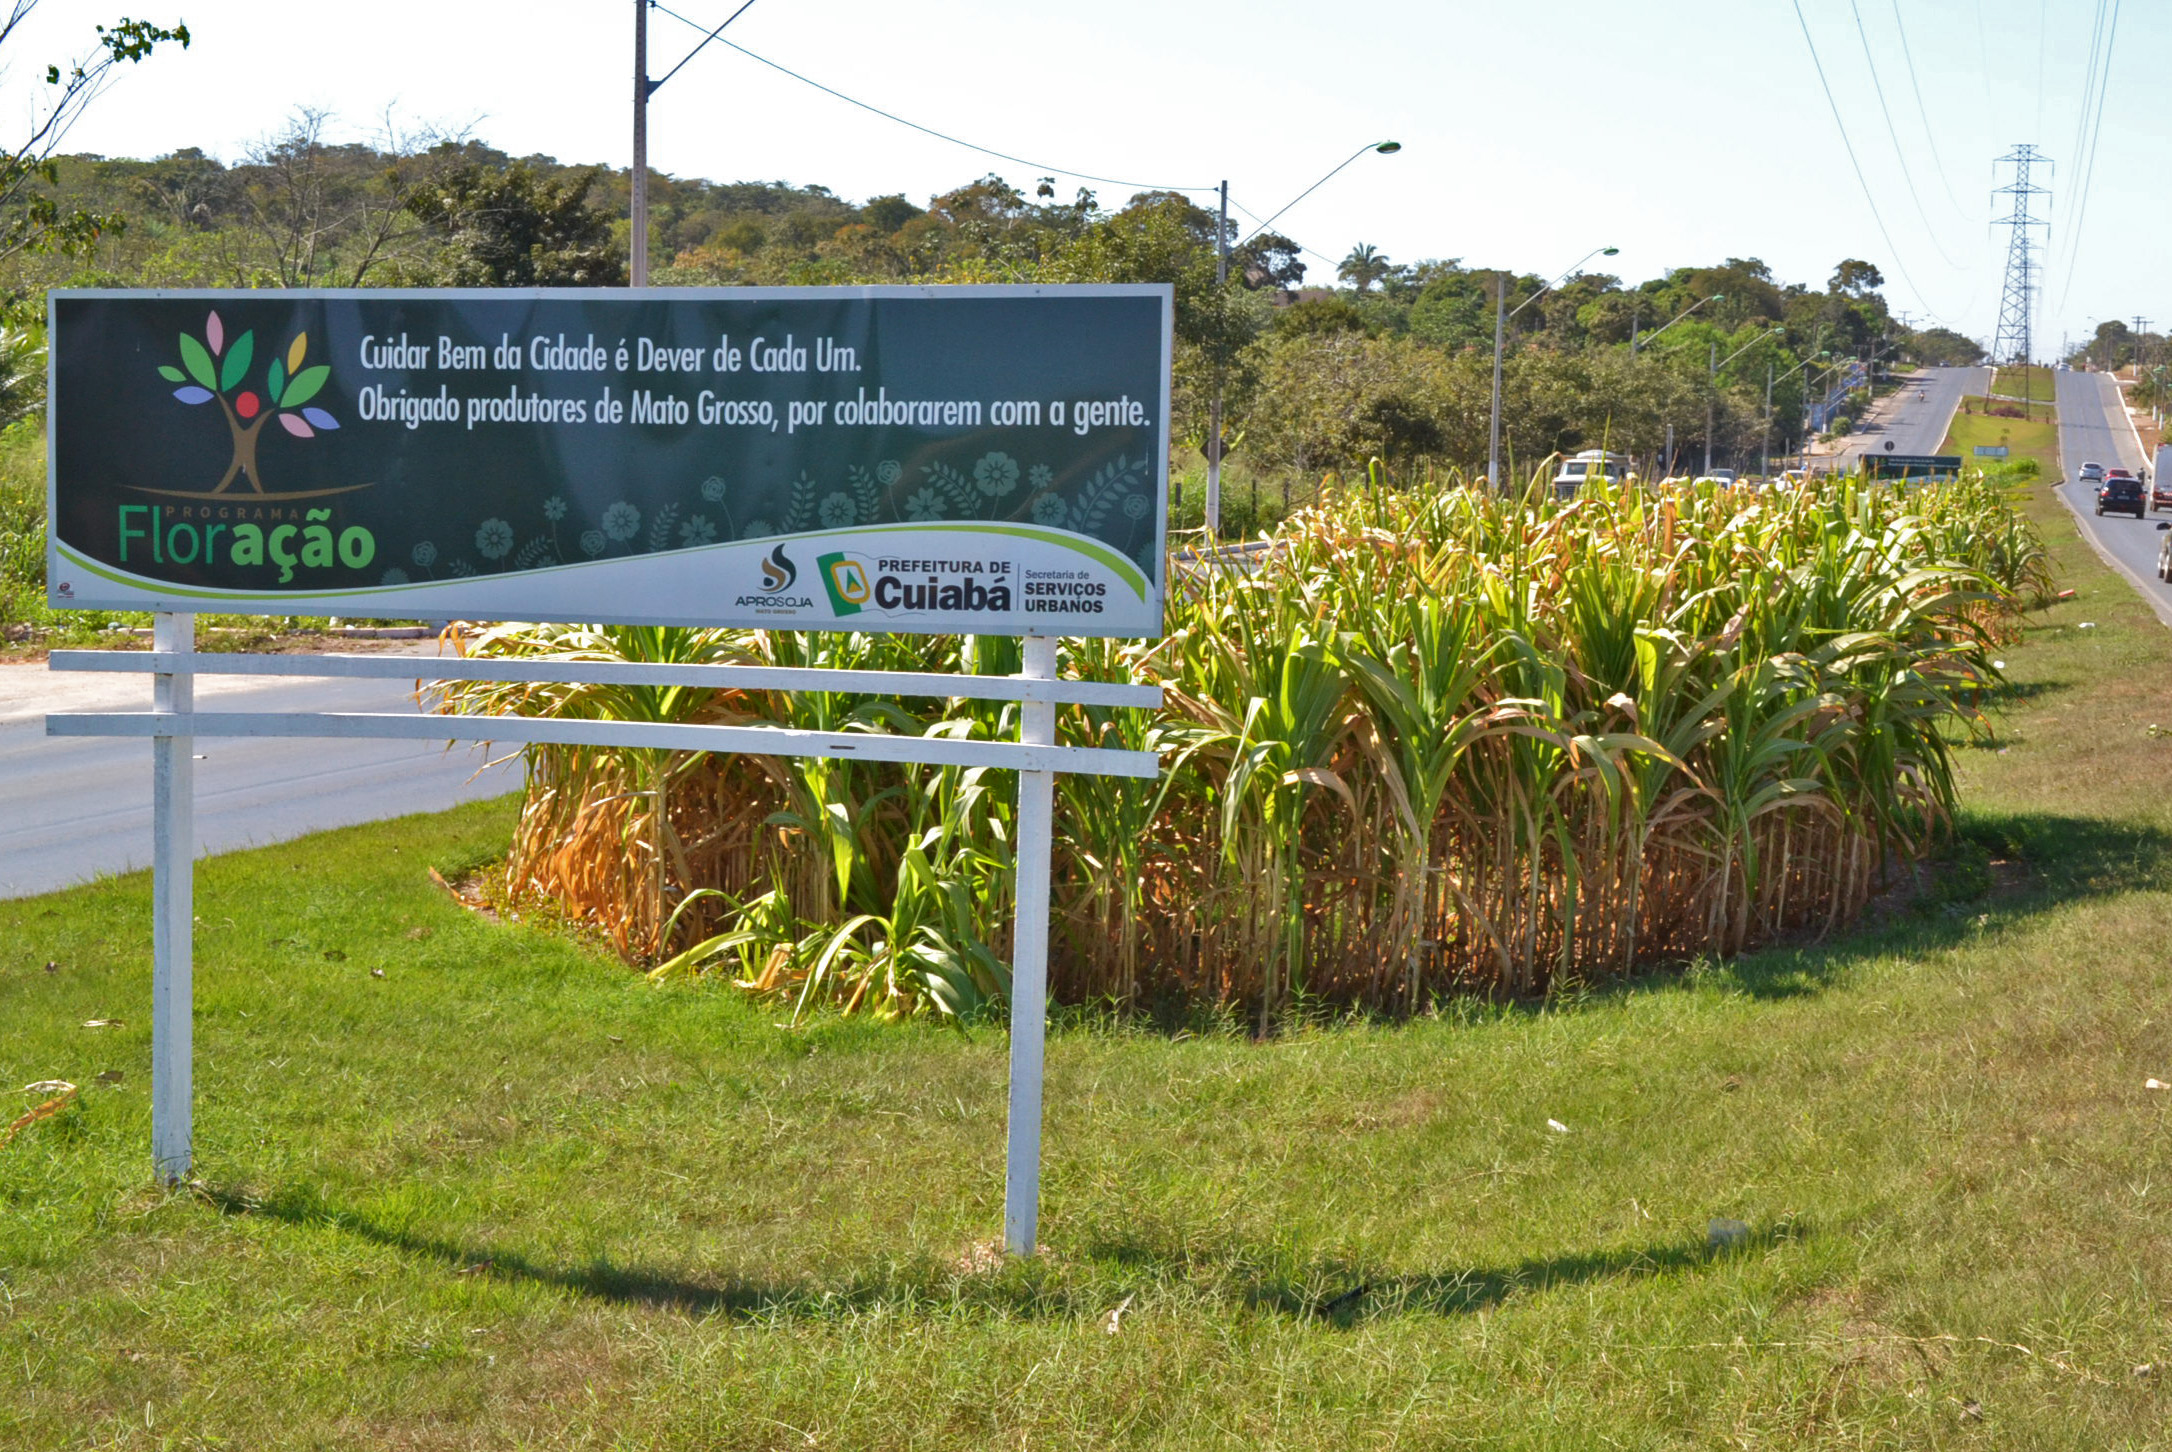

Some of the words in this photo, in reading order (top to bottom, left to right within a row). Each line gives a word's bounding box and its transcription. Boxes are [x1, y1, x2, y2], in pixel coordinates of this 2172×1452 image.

[360, 332, 431, 370] Cuidar
[438, 335, 486, 370] Bem
[493, 332, 522, 370] da
[529, 333, 608, 372] Cidade
[614, 338, 629, 372] é
[637, 337, 706, 372] Dever
[712, 334, 742, 372] de
[750, 333, 807, 372] Cada
[816, 337, 862, 372] Um.
[358, 383, 460, 430] Obrigado
[467, 384, 587, 430] produtores
[594, 386, 623, 424] de
[630, 389, 689, 425] Mato
[697, 389, 779, 433] Grosso,
[788, 401, 828, 434] por
[834, 386, 982, 426] colaborarem
[990, 400, 1041, 426] com
[1049, 400, 1065, 426] a
[1073, 394, 1151, 436] gente.
[165, 505, 298, 520] PROGRAMA
[118, 504, 376, 584] Floração
[878, 559, 984, 574] PREFEITURA
[989, 561, 1012, 574] DE
[1025, 569, 1075, 580] Secretaria
[1077, 571, 1090, 580] de
[874, 575, 1012, 612] Cuiabá
[1024, 582, 1106, 600] SERVIÇOS
[735, 596, 814, 608] APROSOJA
[1025, 599, 1104, 613] URBANOS
